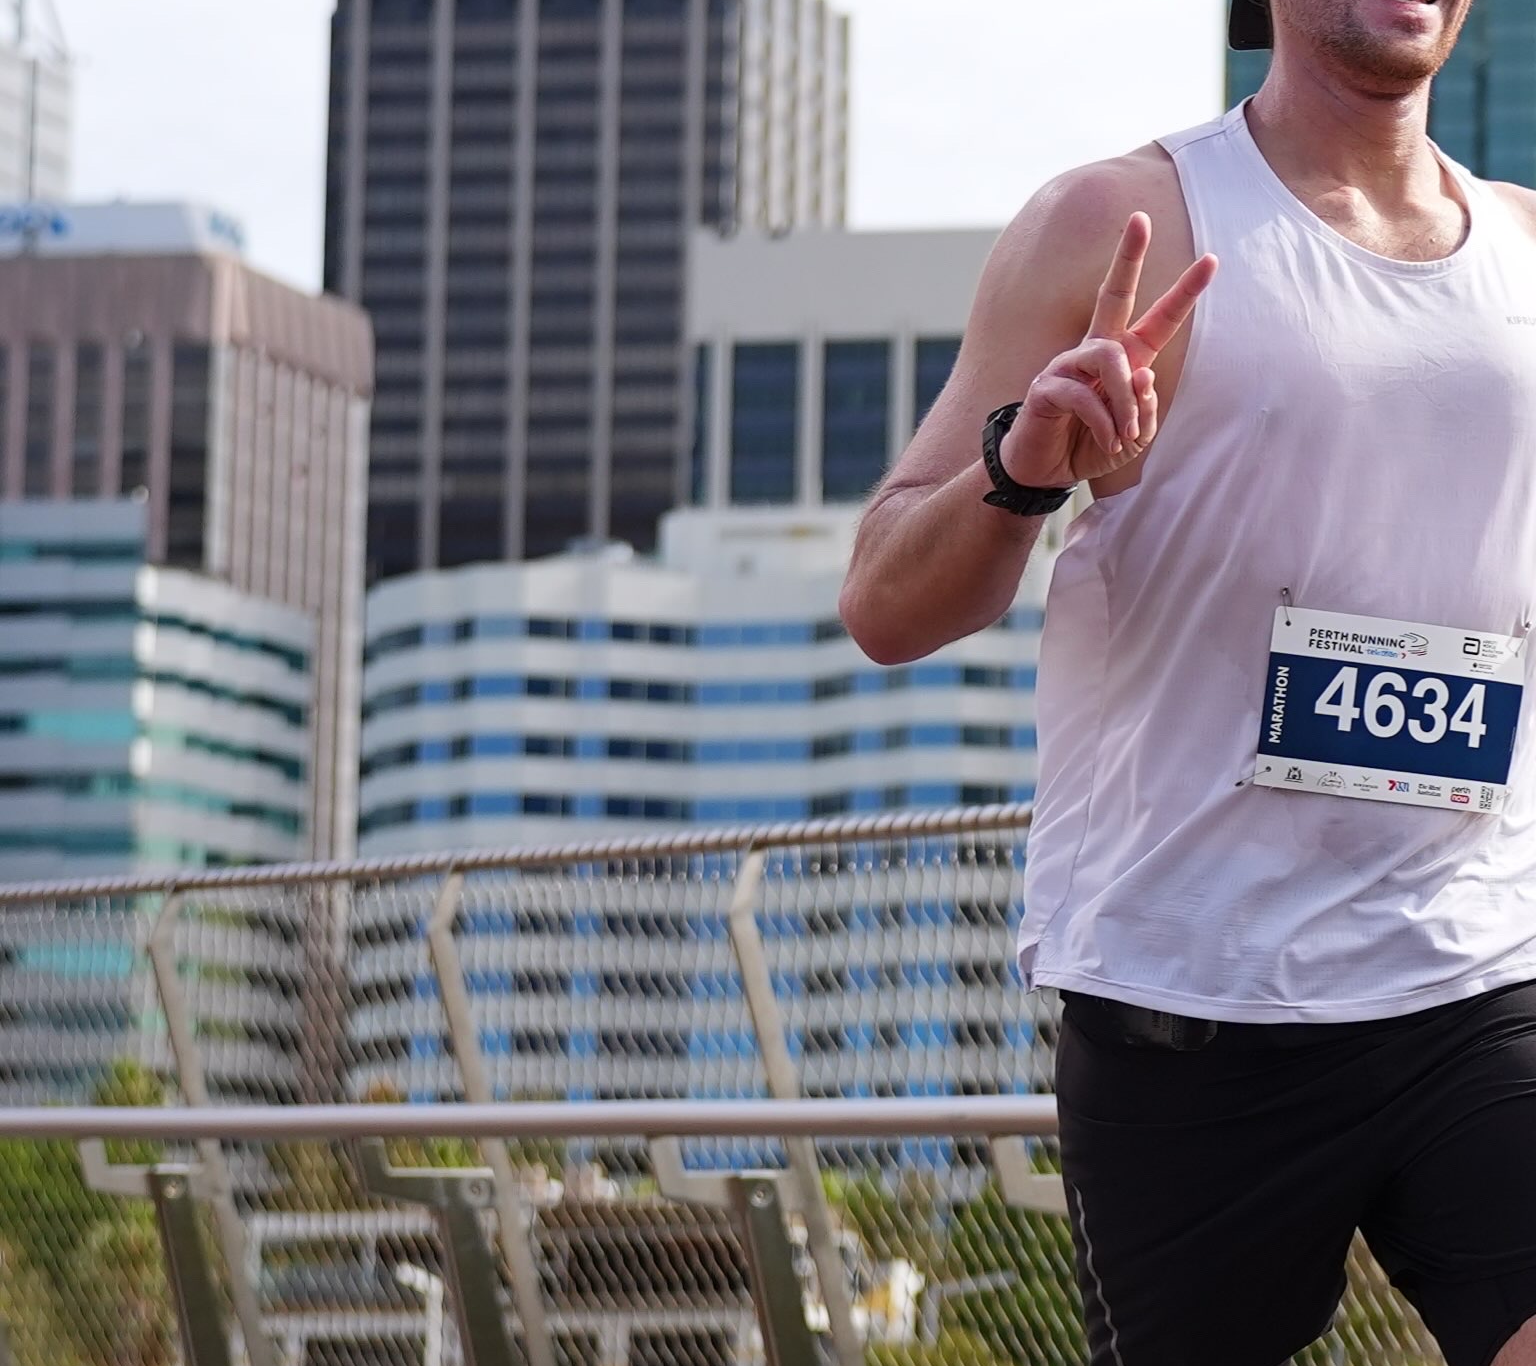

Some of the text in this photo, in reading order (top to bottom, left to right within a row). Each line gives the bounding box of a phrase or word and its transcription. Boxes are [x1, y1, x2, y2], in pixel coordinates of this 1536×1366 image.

[1308, 638, 1364, 655] FESTIVAL
[1309, 628, 1406, 649] PERTH RUNNING
[1269, 666, 1290, 744] MARATHON
[1314, 666, 1487, 749] 4634
